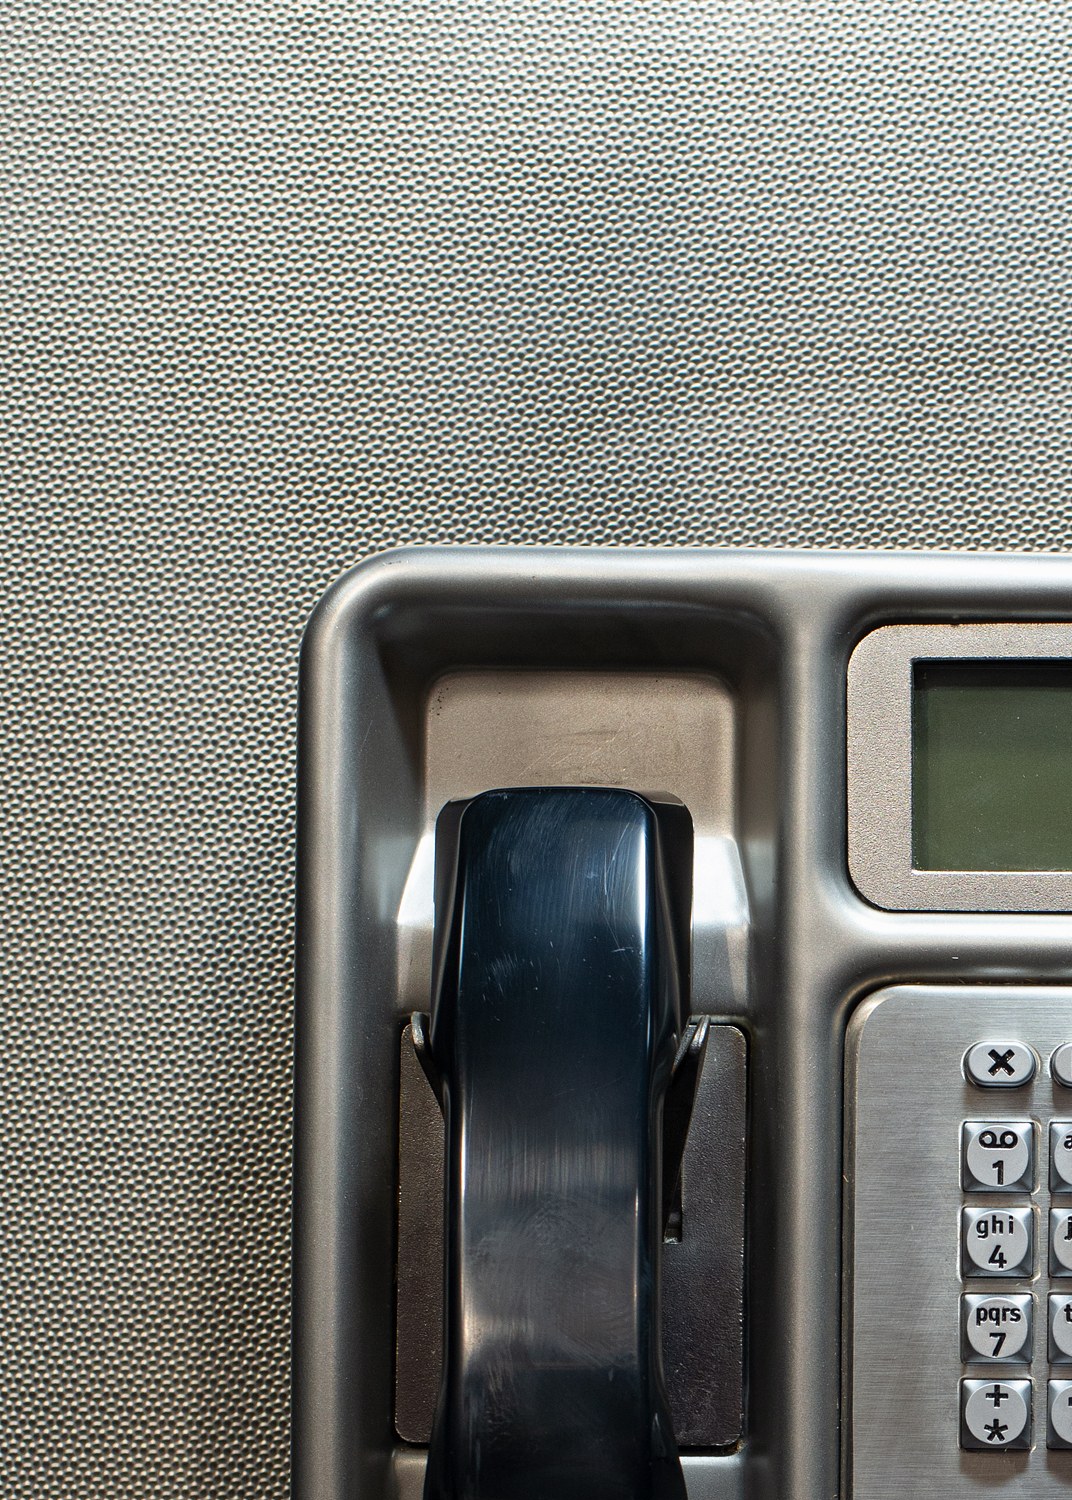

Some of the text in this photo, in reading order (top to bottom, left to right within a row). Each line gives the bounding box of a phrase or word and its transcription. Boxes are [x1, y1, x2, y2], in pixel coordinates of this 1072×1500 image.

[992, 1160, 1004, 1185] 1
[976, 1215, 1014, 1239] ghi
[988, 1245, 1007, 1268] 4
[976, 1306, 1021, 1326] pqrs
[989, 1332, 1006, 1357] 7
